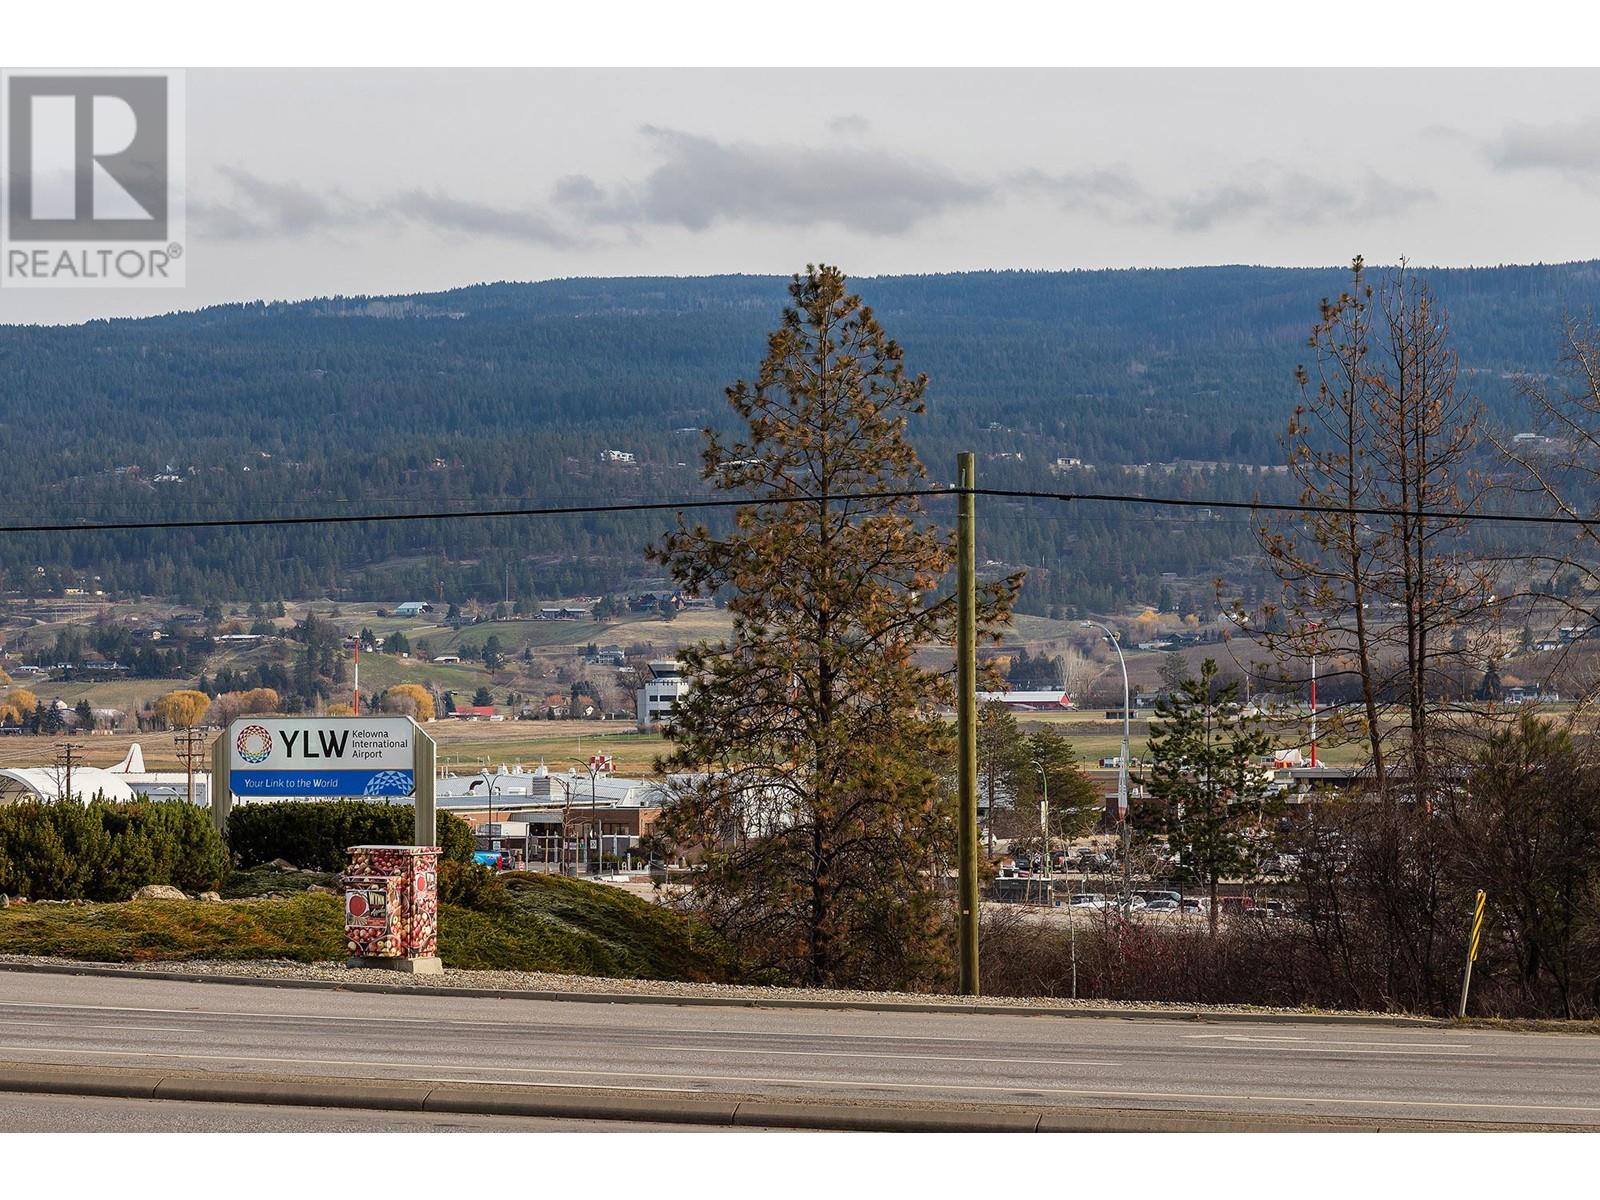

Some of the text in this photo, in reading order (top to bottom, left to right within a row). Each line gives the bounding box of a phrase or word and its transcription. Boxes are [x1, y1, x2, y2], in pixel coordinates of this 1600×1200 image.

[352, 730, 389, 738] Kelowna
[279, 730, 349, 758] YLW
[352, 739, 408, 748] International
[352, 750, 383, 760] Airport
[244, 778, 338, 788] Your Link to the World
